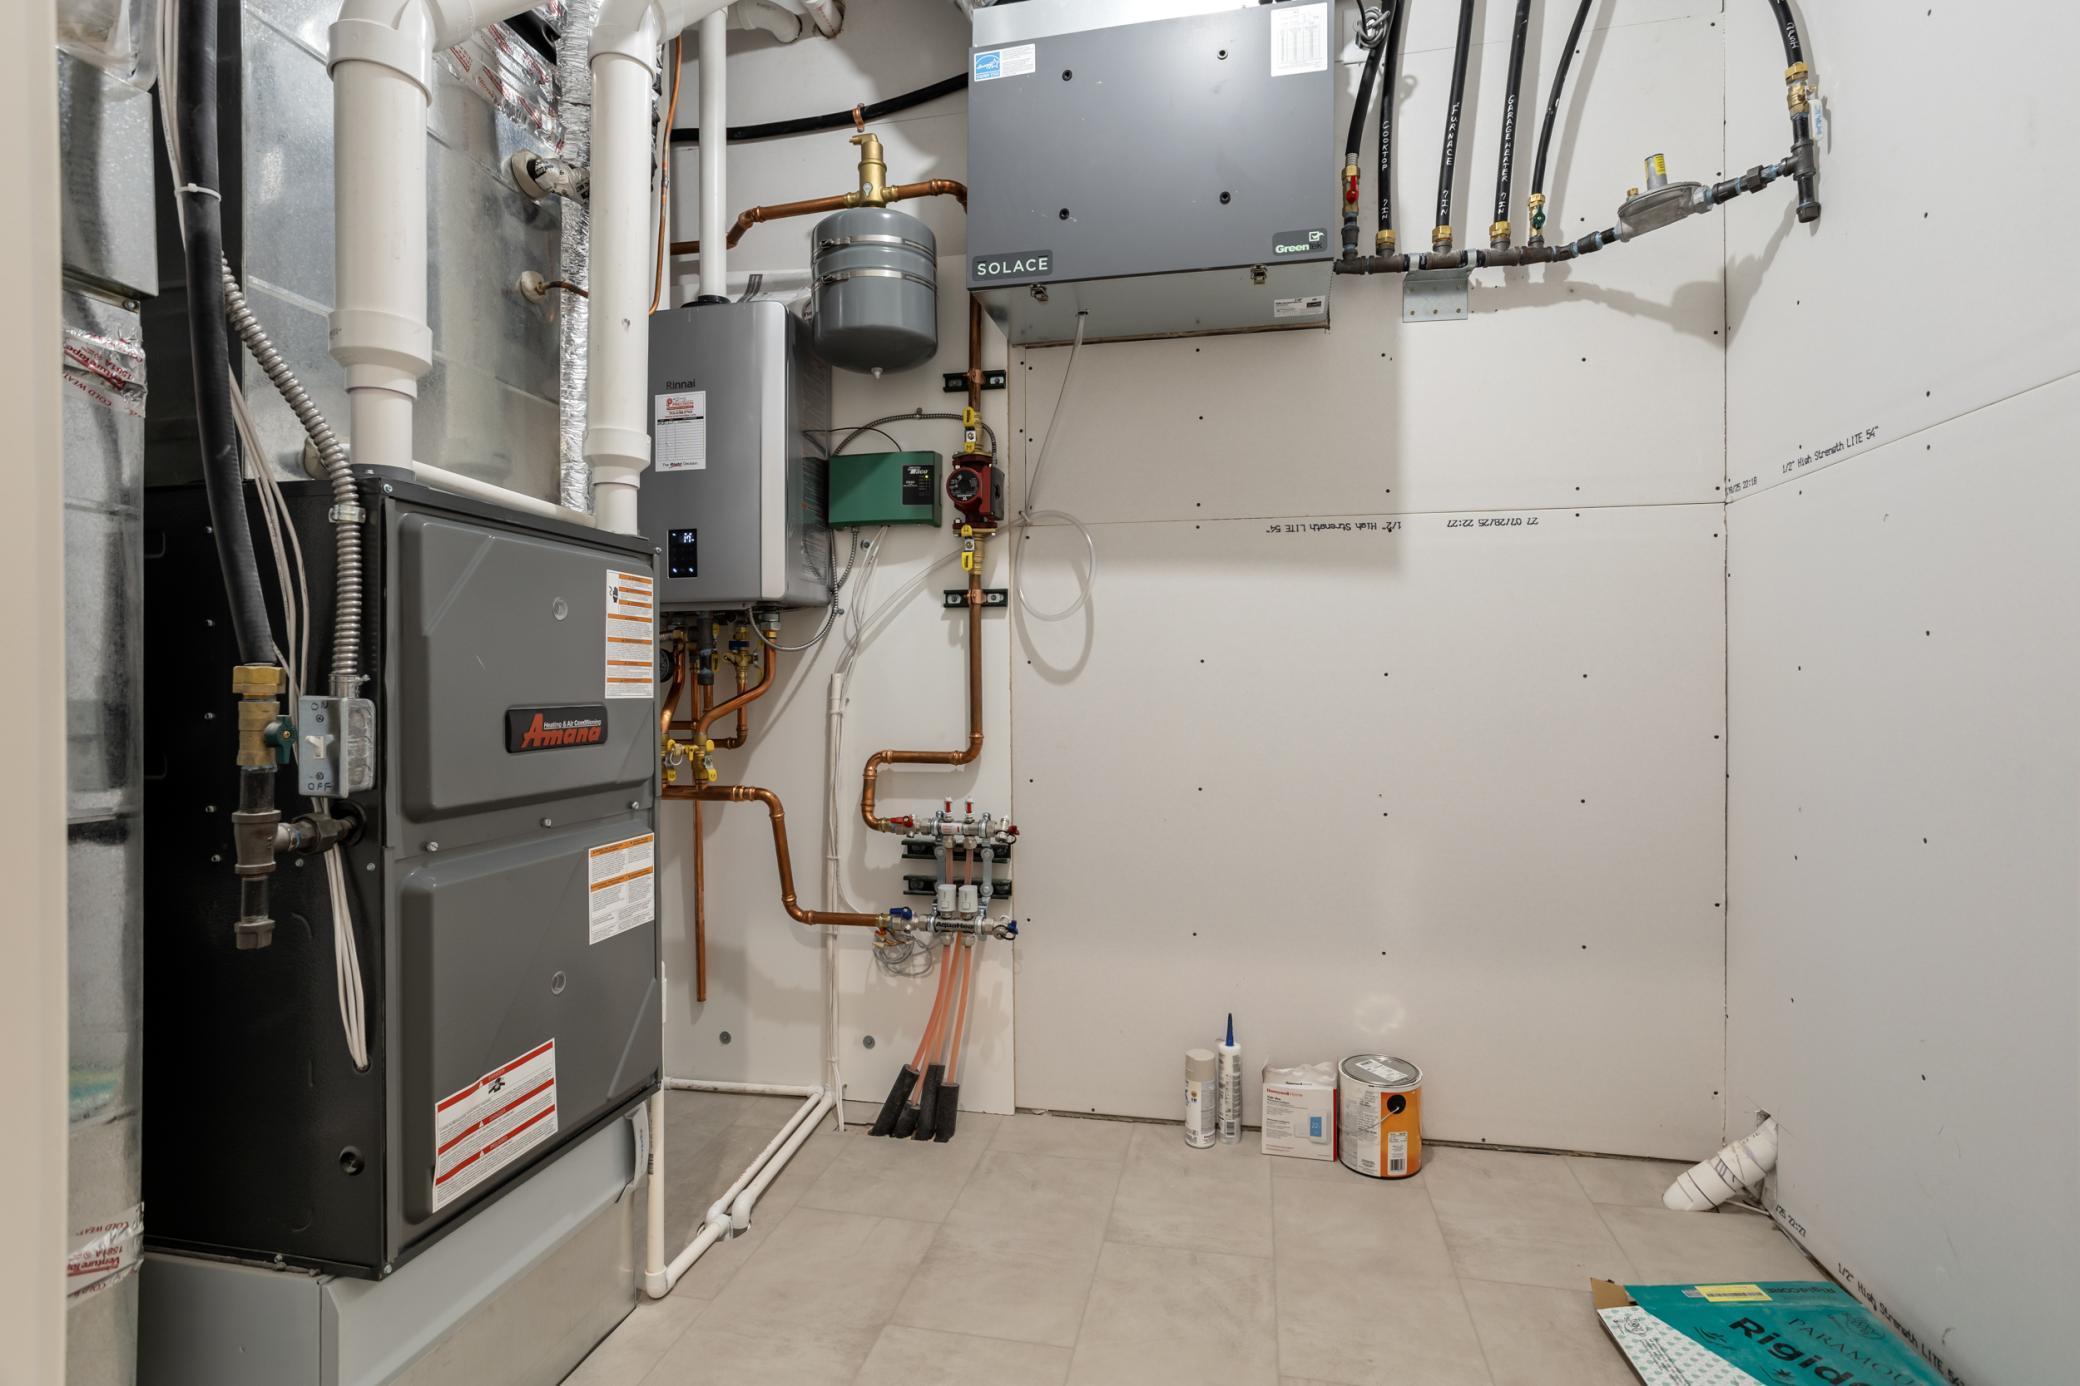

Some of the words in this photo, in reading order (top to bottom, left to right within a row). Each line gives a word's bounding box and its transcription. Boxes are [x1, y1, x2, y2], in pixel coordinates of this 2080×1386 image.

[1446, 102, 1460, 166] FURNACE
[1382, 120, 1391, 171] COOKTOP
[976, 257, 1049, 276] SOLACE
[63, 372, 87, 392] WEAT
[665, 379, 696, 390] Rinnai
[1846, 431, 1863, 448] LITE
[1286, 524, 1306, 533] LITE
[1310, 522, 1352, 532] Strength
[1446, 519, 1474, 528] 22:27
[520, 713, 602, 749] Amana
[307, 782, 333, 791] OFF
[1921, 1343, 1945, 1376] LITE
